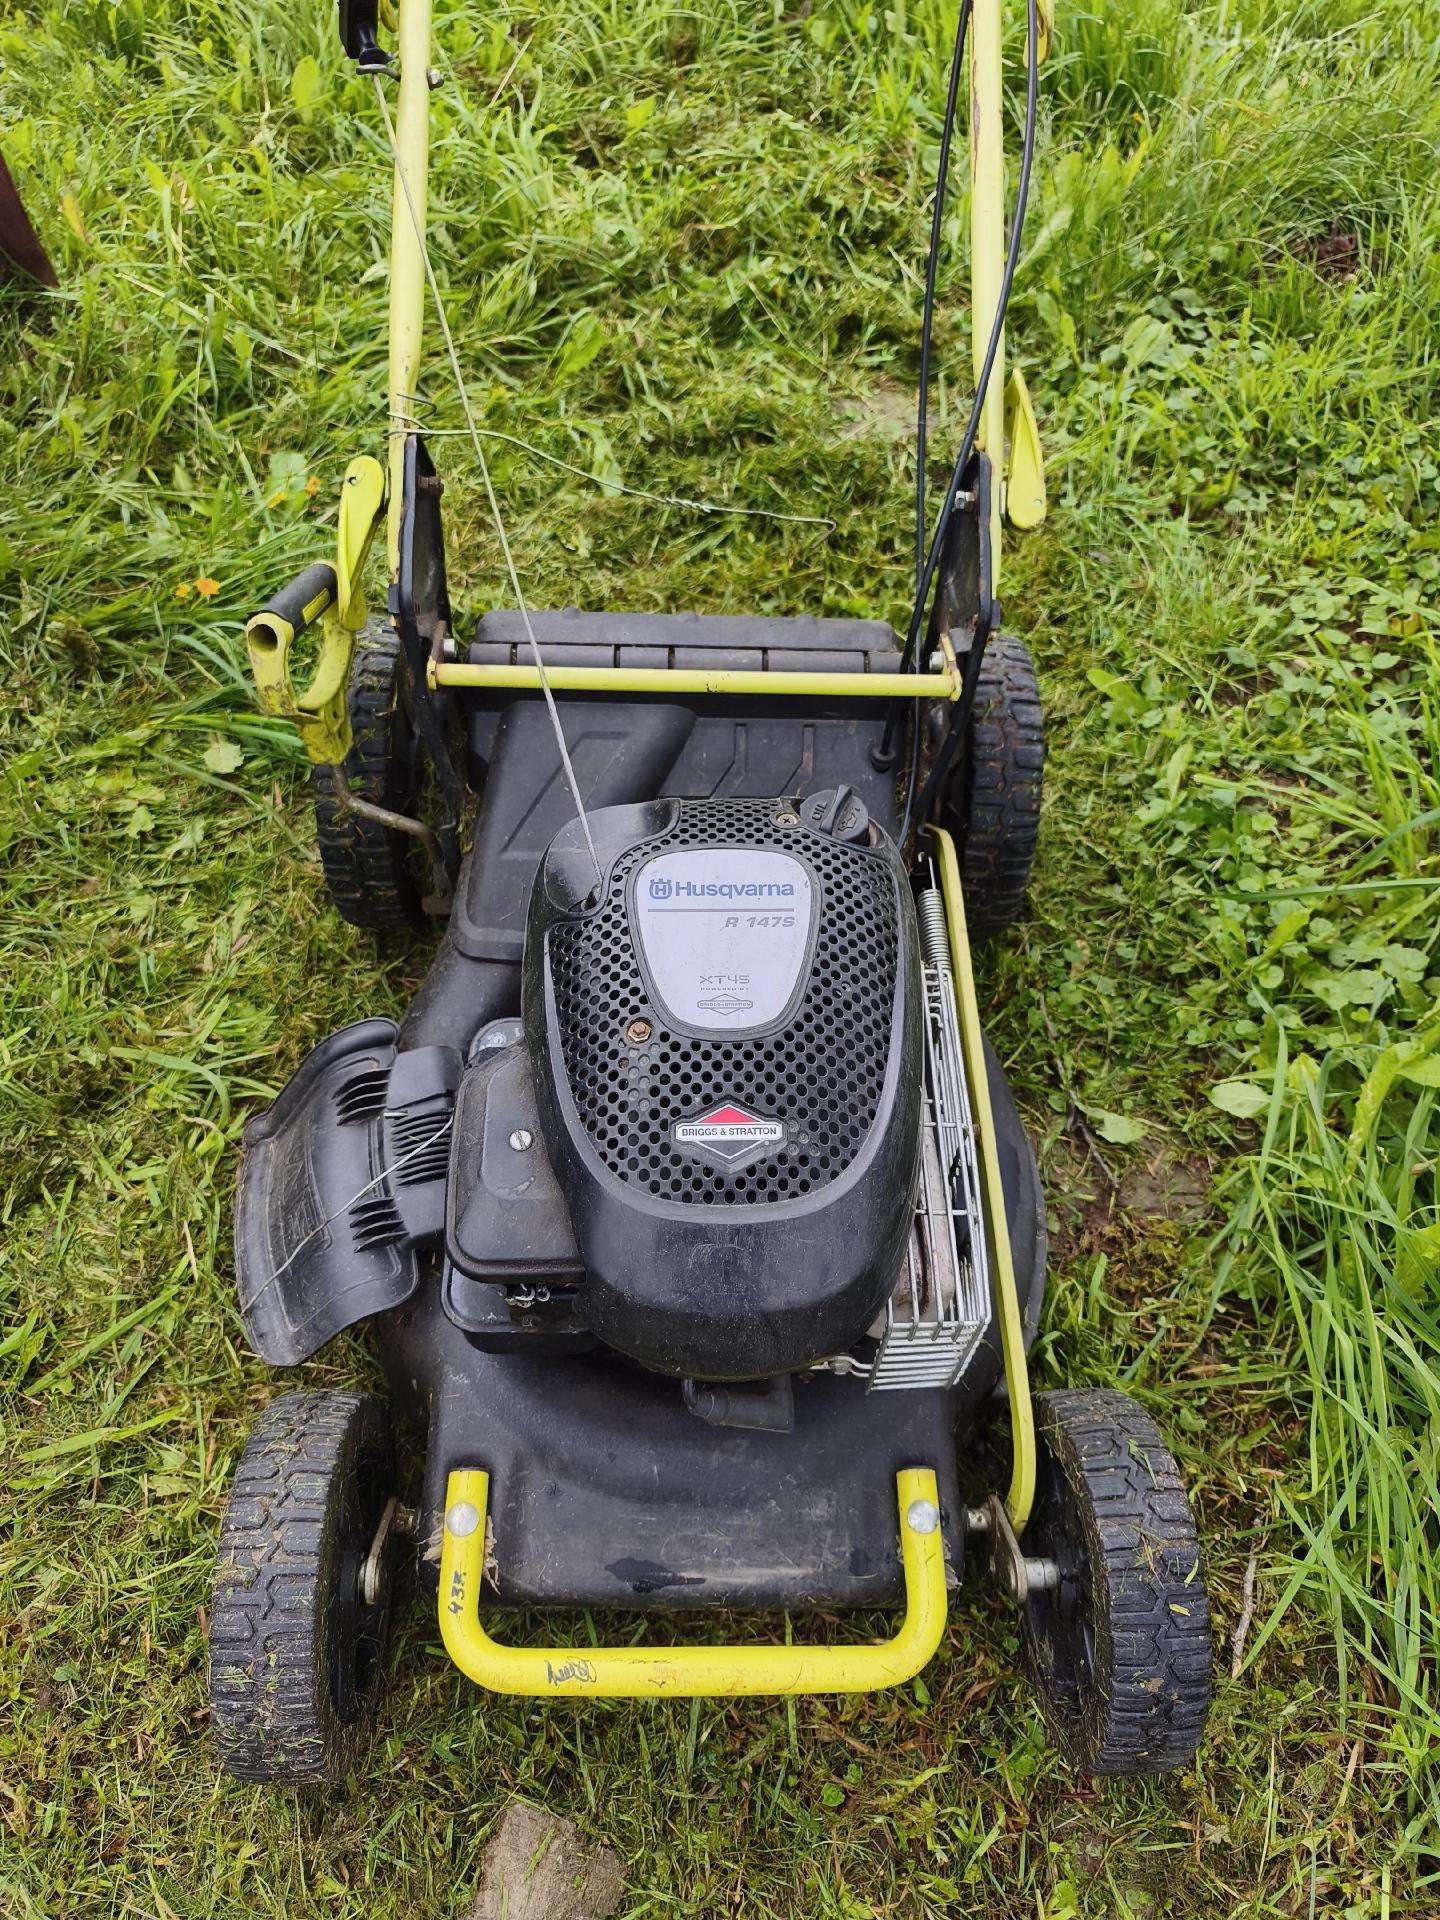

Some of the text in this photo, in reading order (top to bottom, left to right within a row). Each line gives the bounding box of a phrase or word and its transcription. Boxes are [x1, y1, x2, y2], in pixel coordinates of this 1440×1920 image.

[811, 802, 829, 821] OIL
[675, 881, 795, 899] Husqvarna
[724, 916, 739, 928] R
[681, 1126, 777, 1137] BRIGGS & STRATTON
